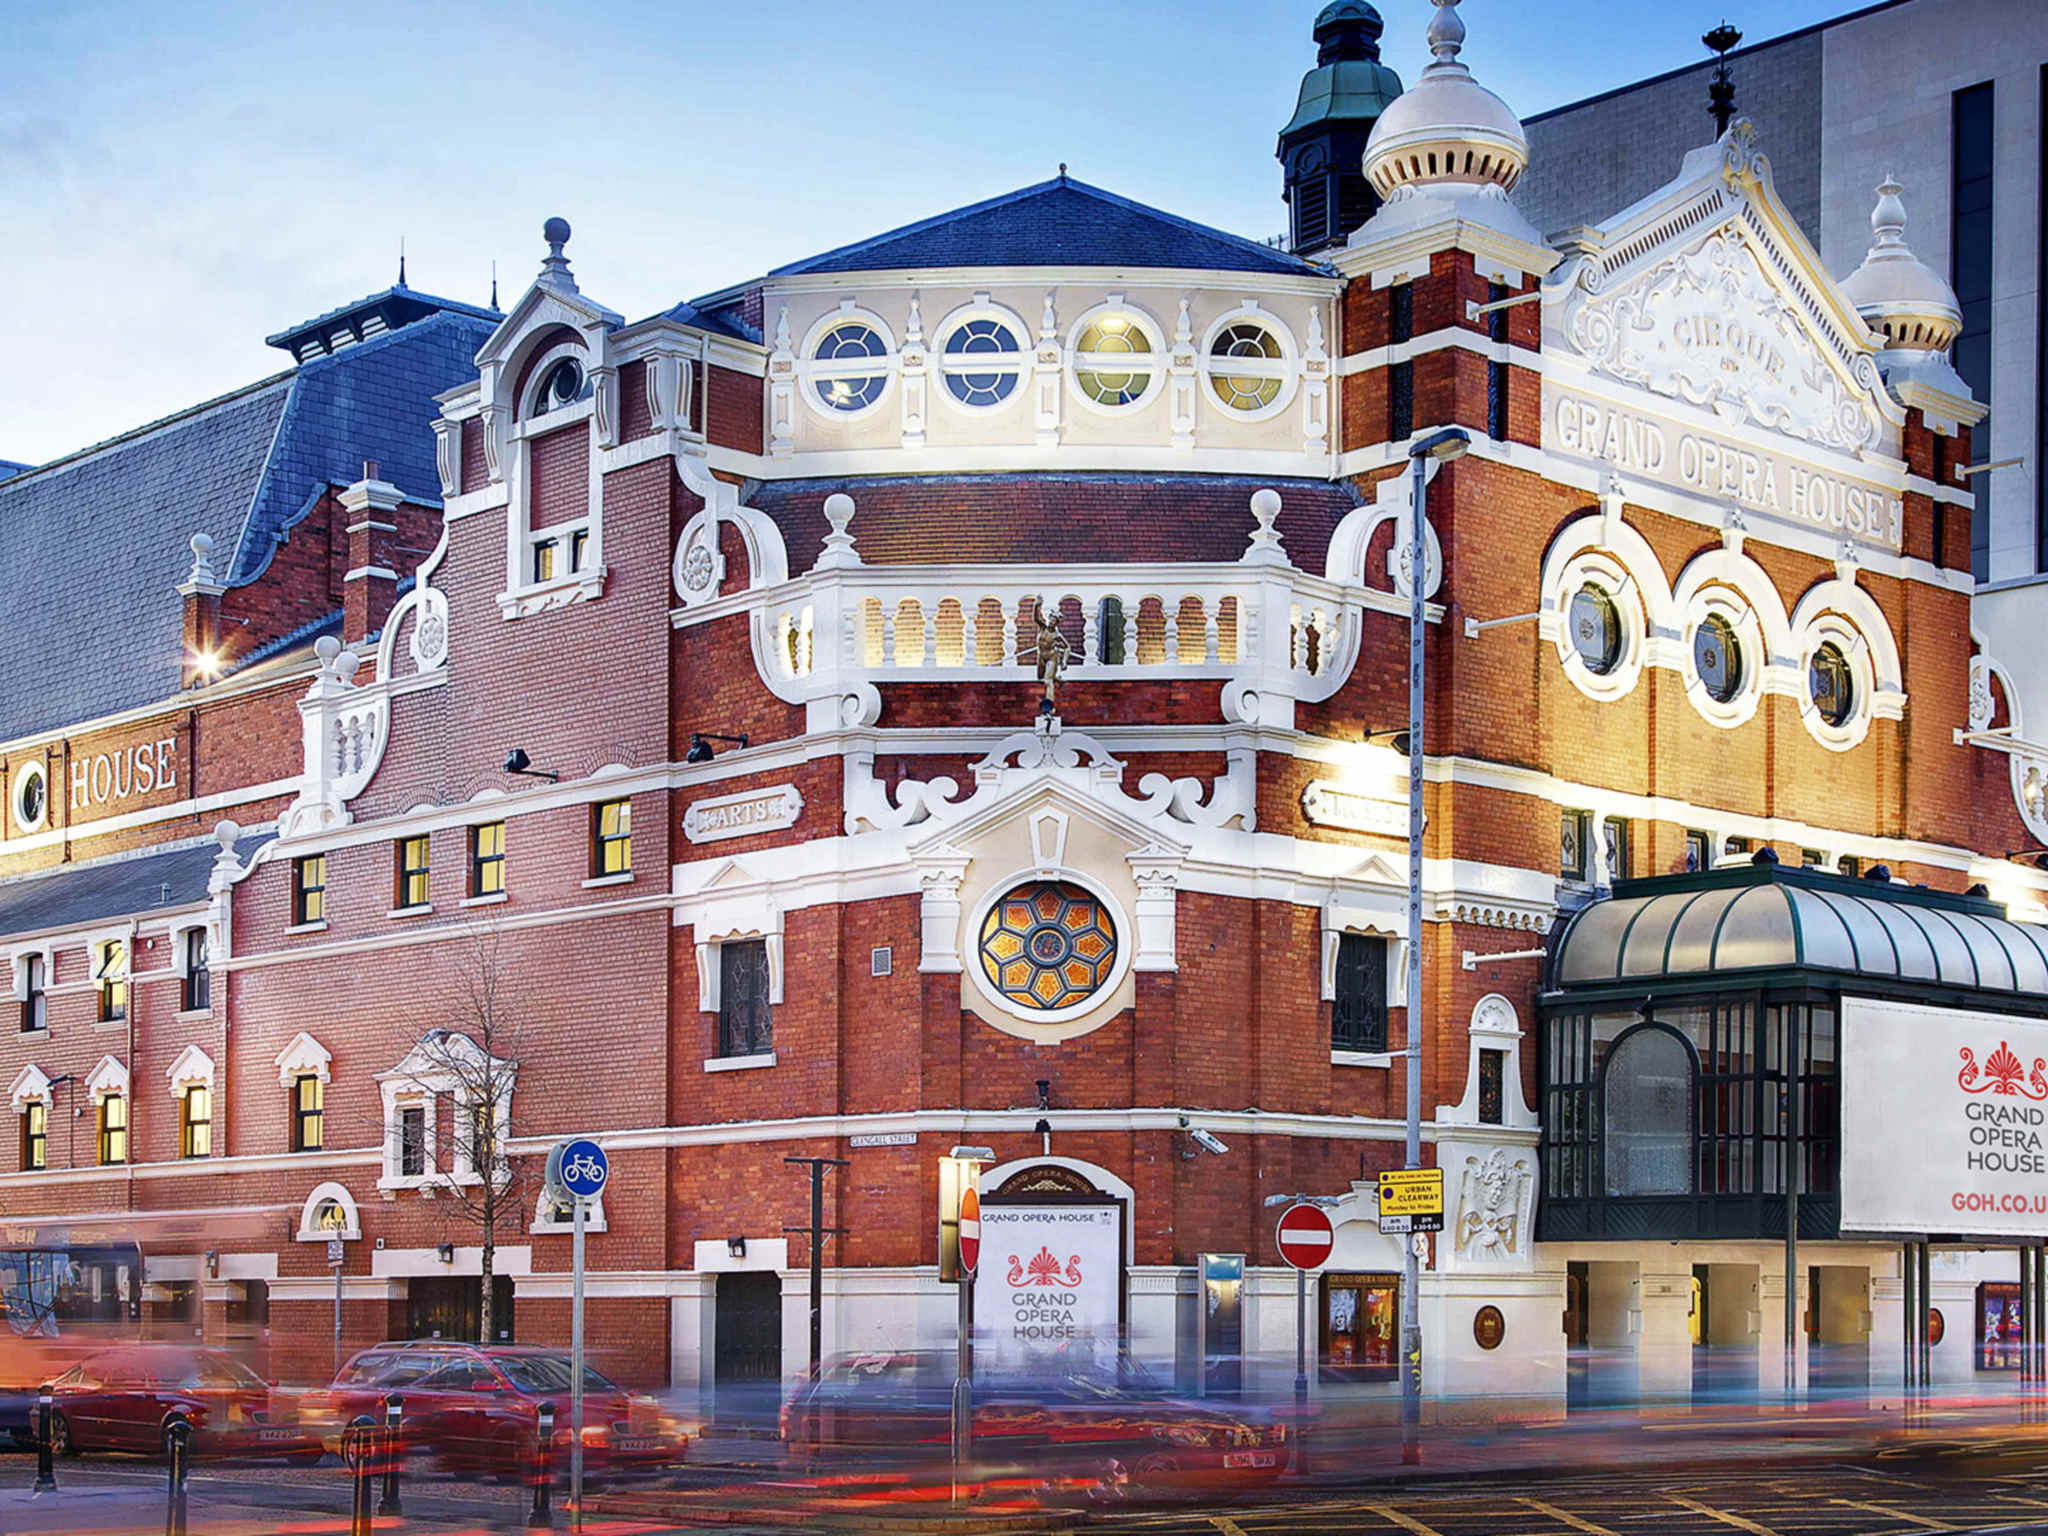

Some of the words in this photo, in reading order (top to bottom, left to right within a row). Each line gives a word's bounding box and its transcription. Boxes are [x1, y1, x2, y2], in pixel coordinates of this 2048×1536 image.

[1673, 315, 1786, 384] CIRQUE
[1555, 396, 1665, 475] GRAND
[1679, 434, 1781, 511] OPERA
[1789, 466, 1886, 539] HOUSE
[70, 737, 177, 810] HOUSE
[717, 801, 769, 827] ARTS
[1965, 1102, 2044, 1127] GRAND
[1969, 1126, 2042, 1153] OPERA
[1967, 1151, 2045, 1173] HOUSE
[982, 1213, 1019, 1223] GRAND
[1022, 1213, 1056, 1223] OPERA
[1060, 1213, 1095, 1222] HOUSE
[1012, 1293, 1077, 1308] GRAND
[1015, 1309, 1074, 1325] OPERA
[1013, 1325, 1075, 1339] HOUSE
